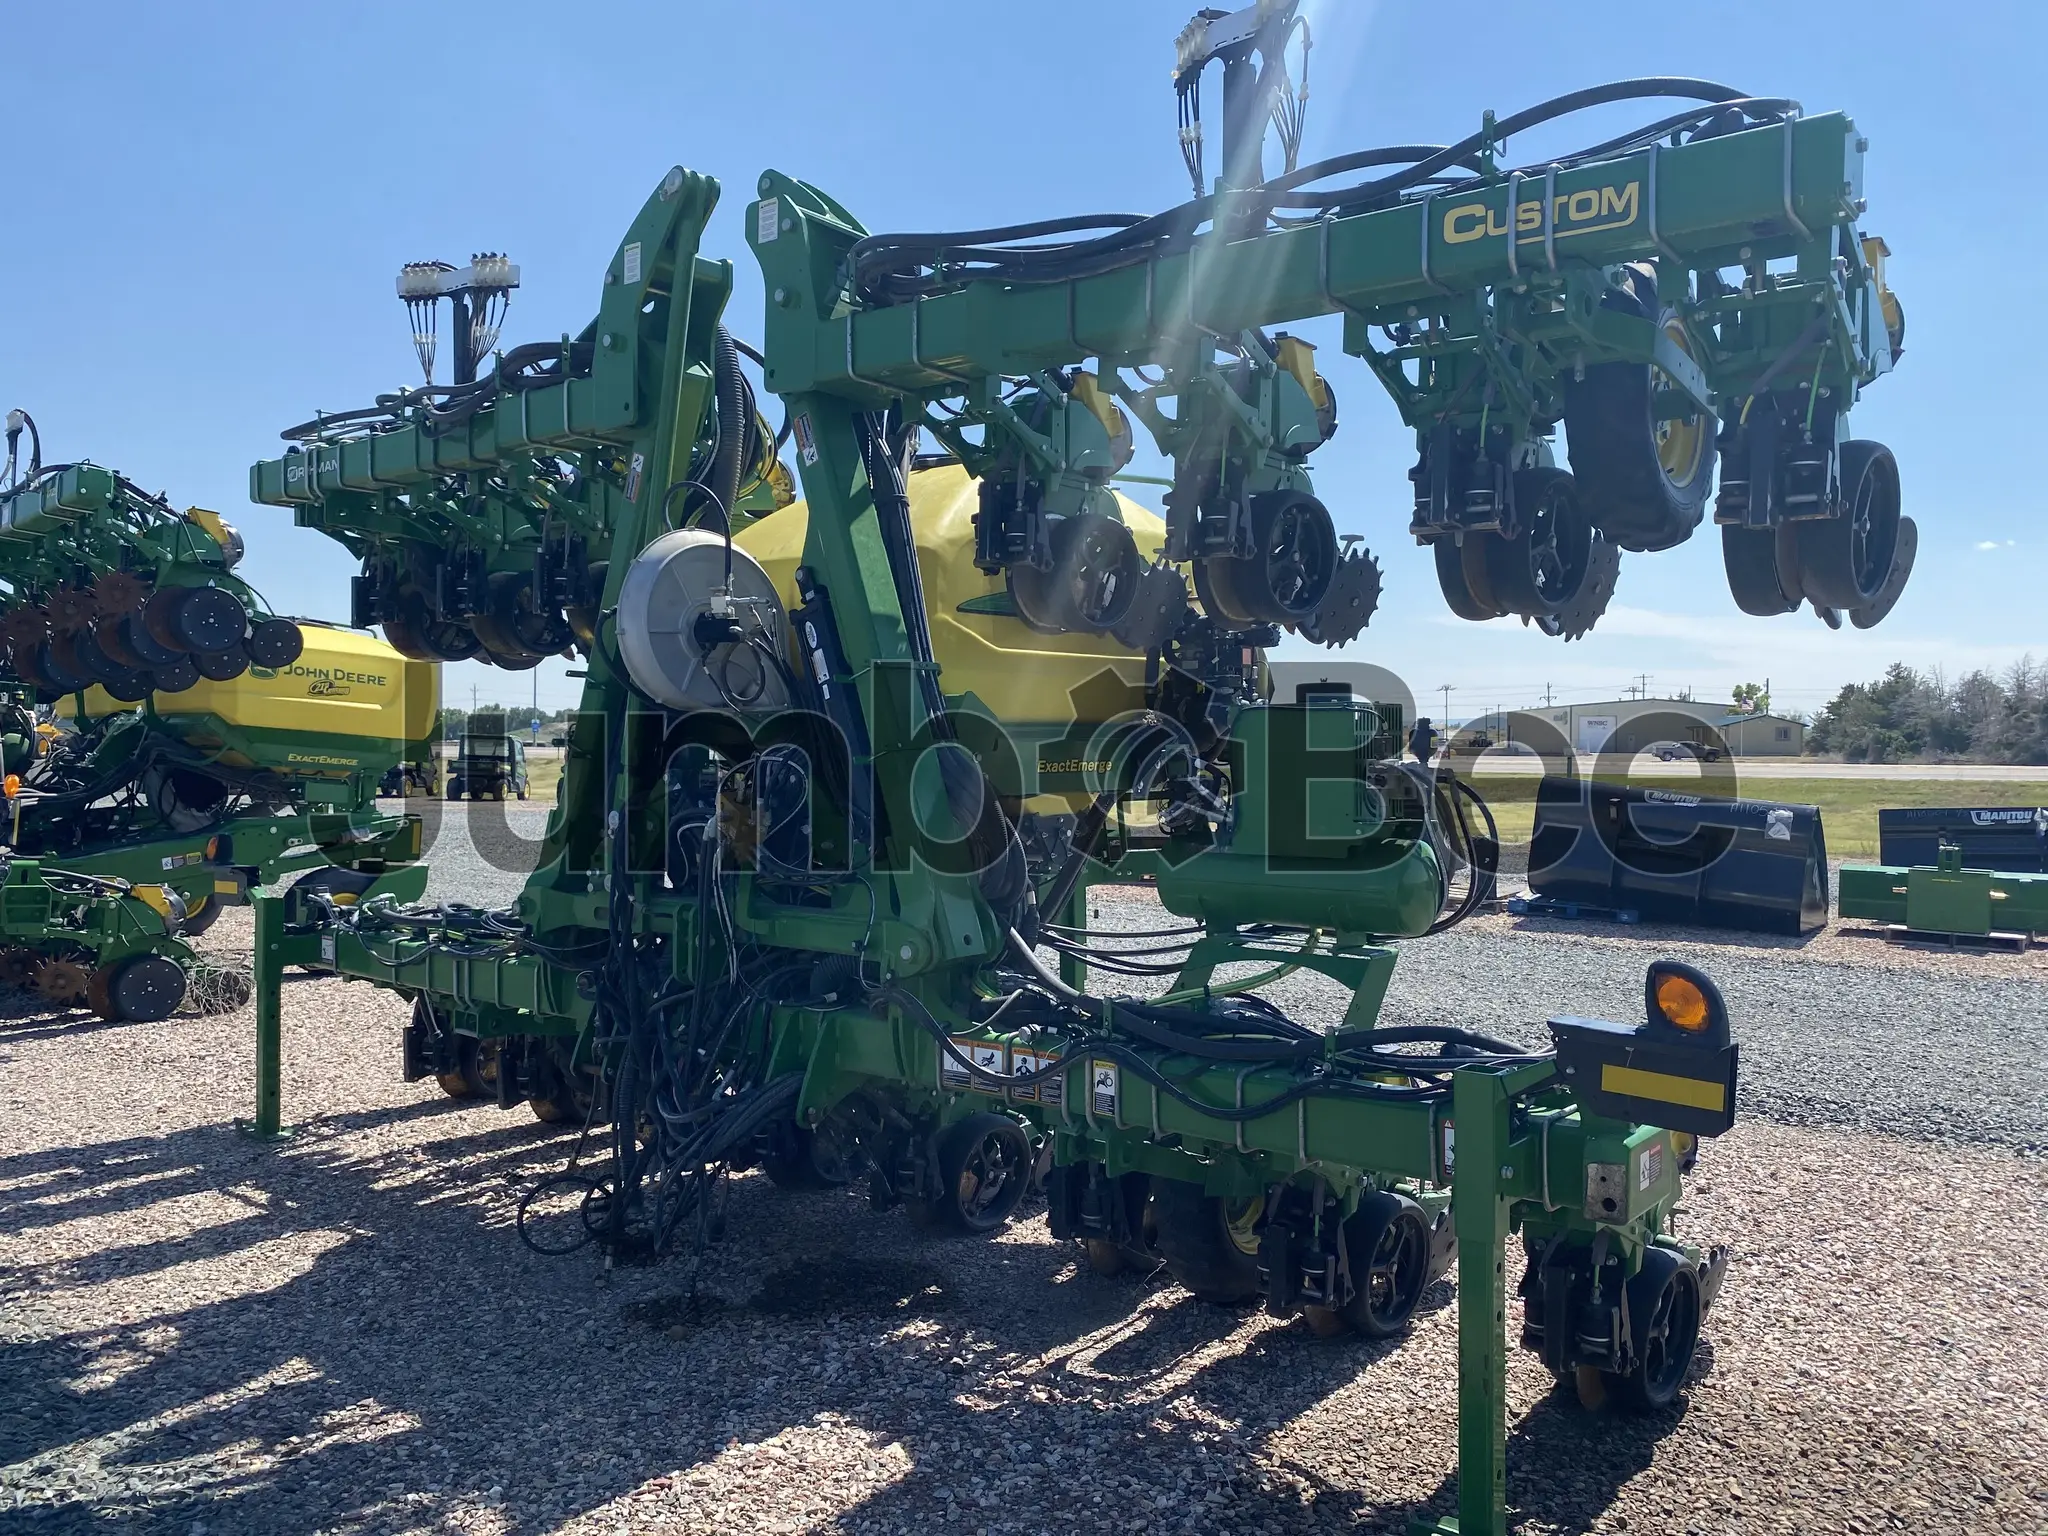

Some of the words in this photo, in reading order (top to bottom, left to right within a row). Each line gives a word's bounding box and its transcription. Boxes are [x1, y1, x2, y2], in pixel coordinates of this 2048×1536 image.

[333, 668, 387, 687] DEERE
[1037, 759, 1112, 773] ExactEmerge
[1651, 791, 1701, 803] MANITOU
[1980, 811, 2032, 821] MANITOU
